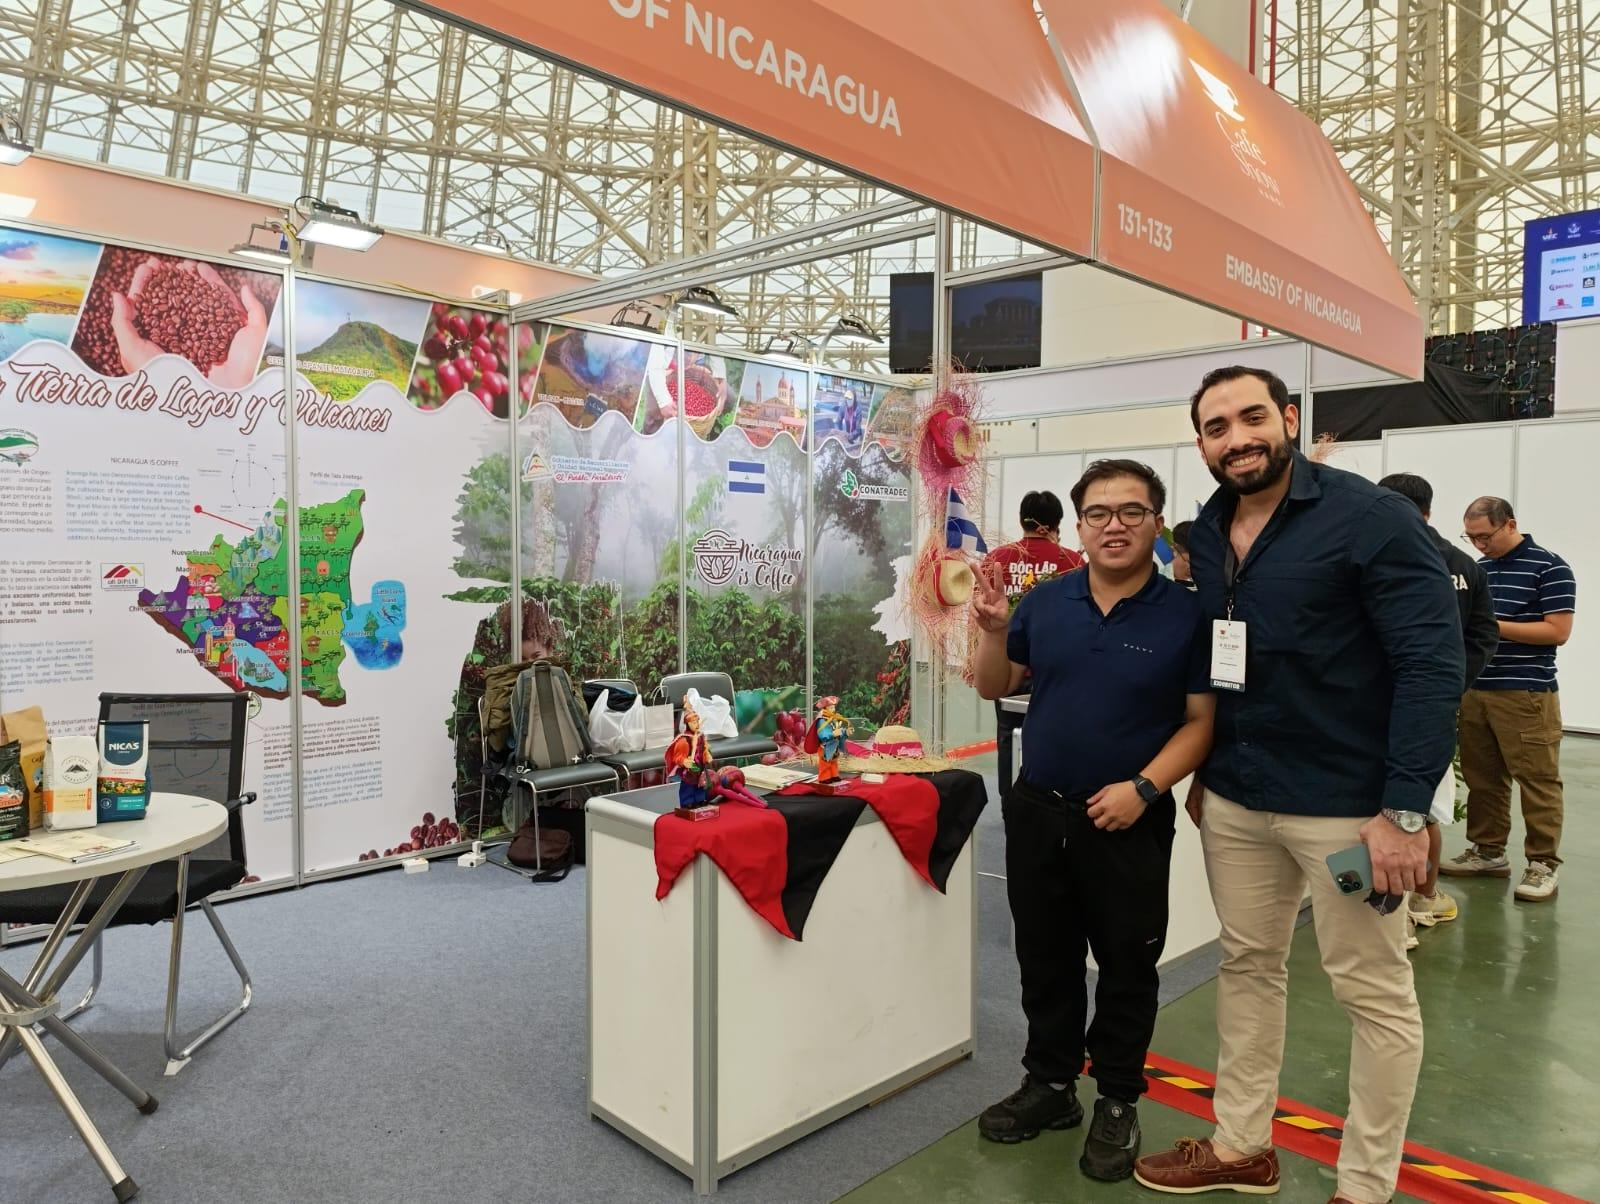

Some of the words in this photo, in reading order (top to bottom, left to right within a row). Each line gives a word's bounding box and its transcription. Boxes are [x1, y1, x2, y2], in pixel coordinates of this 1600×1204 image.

[607, 0, 670, 29] OF
[685, 2, 902, 137] NICARAGUA
[1118, 203, 1173, 252] 131-133
[1226, 254, 1284, 299] EMBASSY
[1286, 283, 1302, 306] OF
[1304, 292, 1362, 335] NICARAGUA
[9, 361, 111, 405] Tierra
[116, 369, 158, 410] de
[159, 376, 239, 428] Lagos
[240, 396, 267, 434] y
[270, 389, 392, 433] Volcanes
[110, 457, 148, 465] NICARAGUA
[859, 485, 907, 497] CONATRADEC
[740, 538, 801, 566] Nicaragua
[738, 568, 749, 585] is
[755, 561, 793, 592] Coffee
